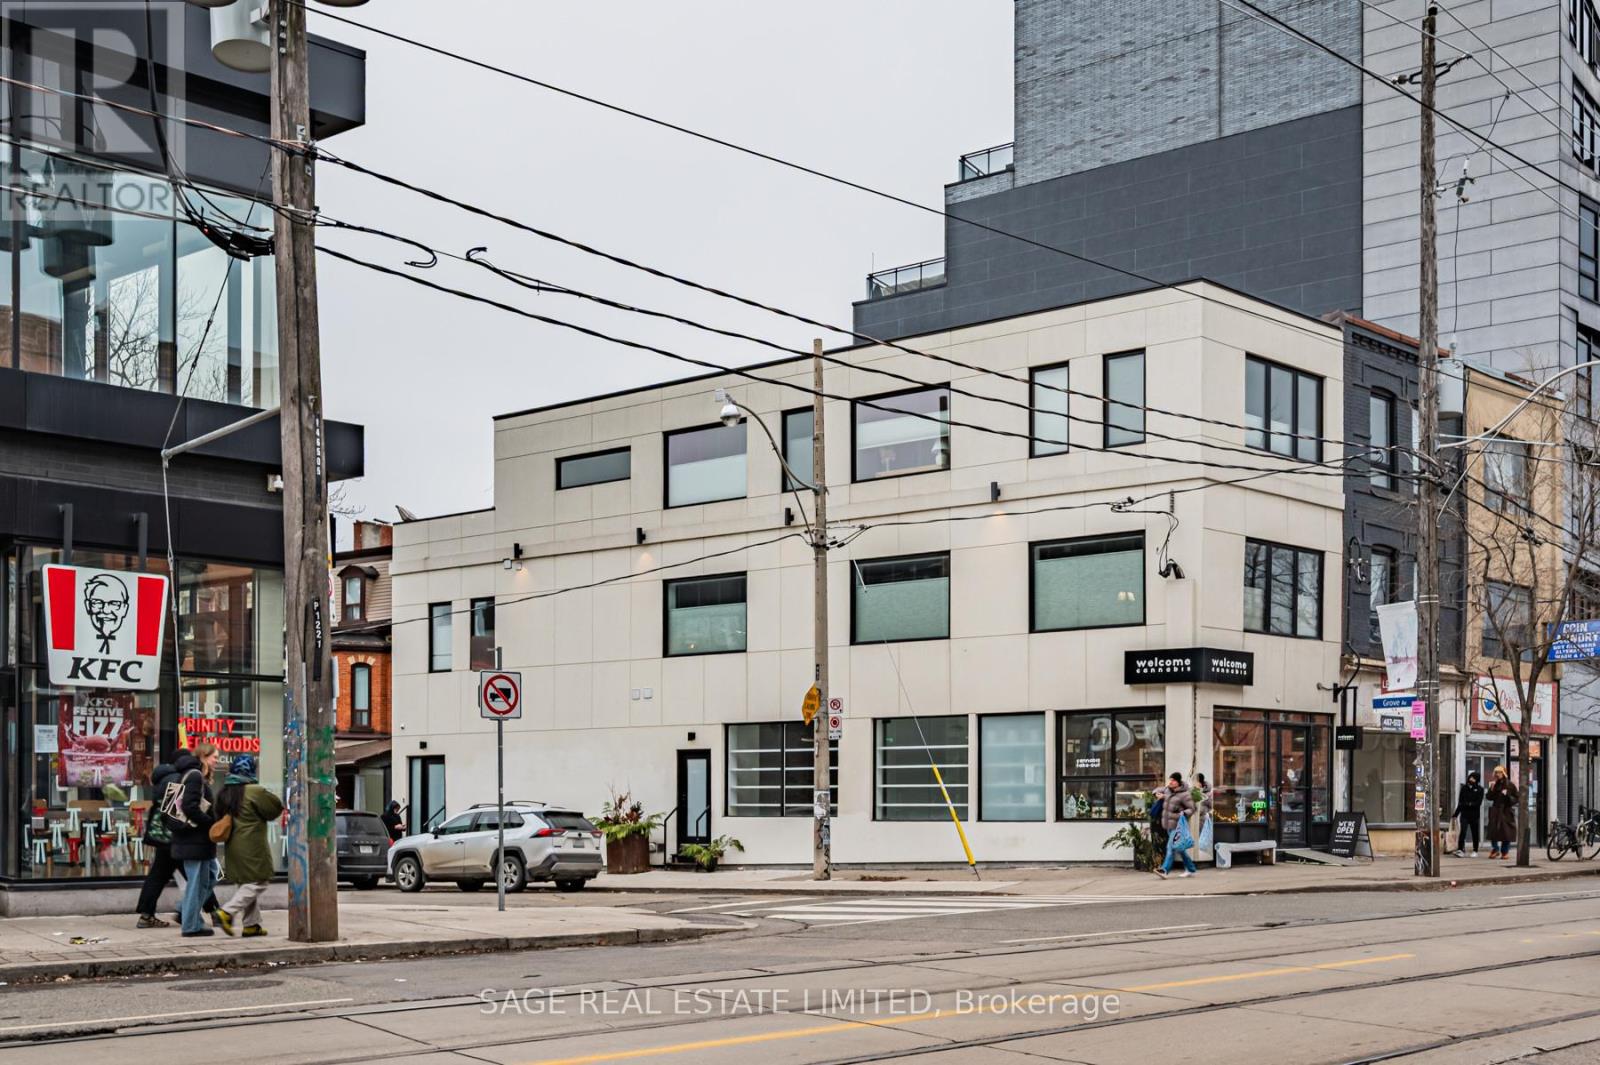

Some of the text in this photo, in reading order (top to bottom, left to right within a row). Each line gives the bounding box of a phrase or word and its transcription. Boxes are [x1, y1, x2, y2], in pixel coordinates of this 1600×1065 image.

[312, 600, 322, 648] P1221
[1563, 622, 1588, 633] COIN
[1136, 657, 1191, 668] welcome
[1211, 657, 1247, 670] welcome
[67, 656, 143, 683] KFC
[1136, 666, 1191, 674] cannabis
[1211, 667, 1247, 676] cannabis
[84, 697, 113, 707] KFC
[1382, 699, 1400, 707] Grove
[73, 706, 124, 716] FESTIVE
[72, 716, 124, 739] FIZZ
